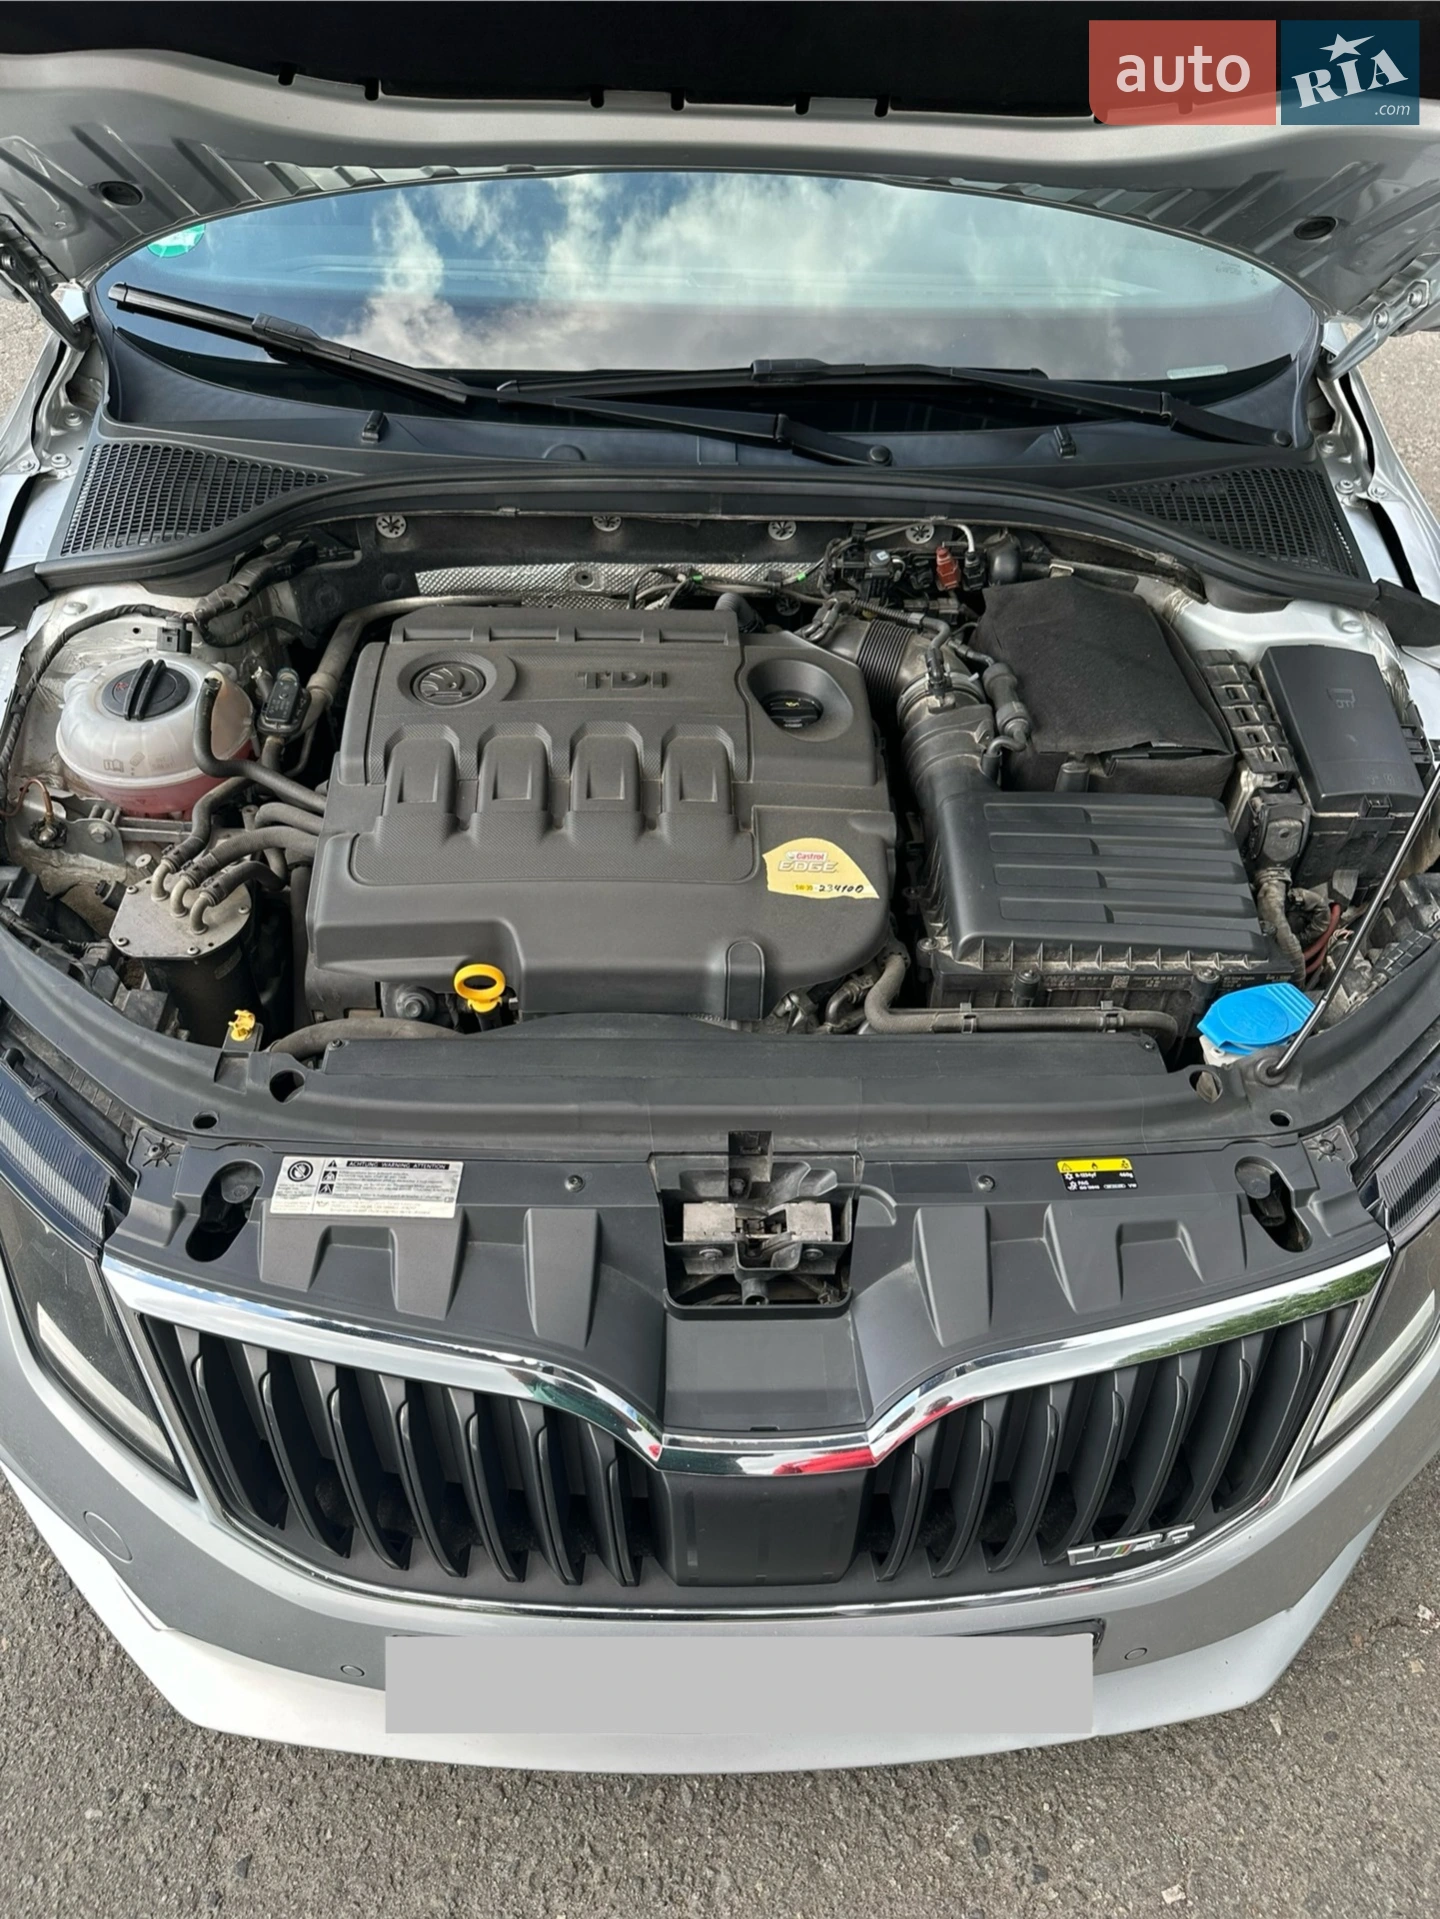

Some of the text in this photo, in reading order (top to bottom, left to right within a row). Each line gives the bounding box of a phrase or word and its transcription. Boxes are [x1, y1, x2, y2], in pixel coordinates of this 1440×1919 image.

[575, 671, 667, 690] TDI
[796, 852, 825, 860] Castrol
[778, 860, 838, 873] EDGE
